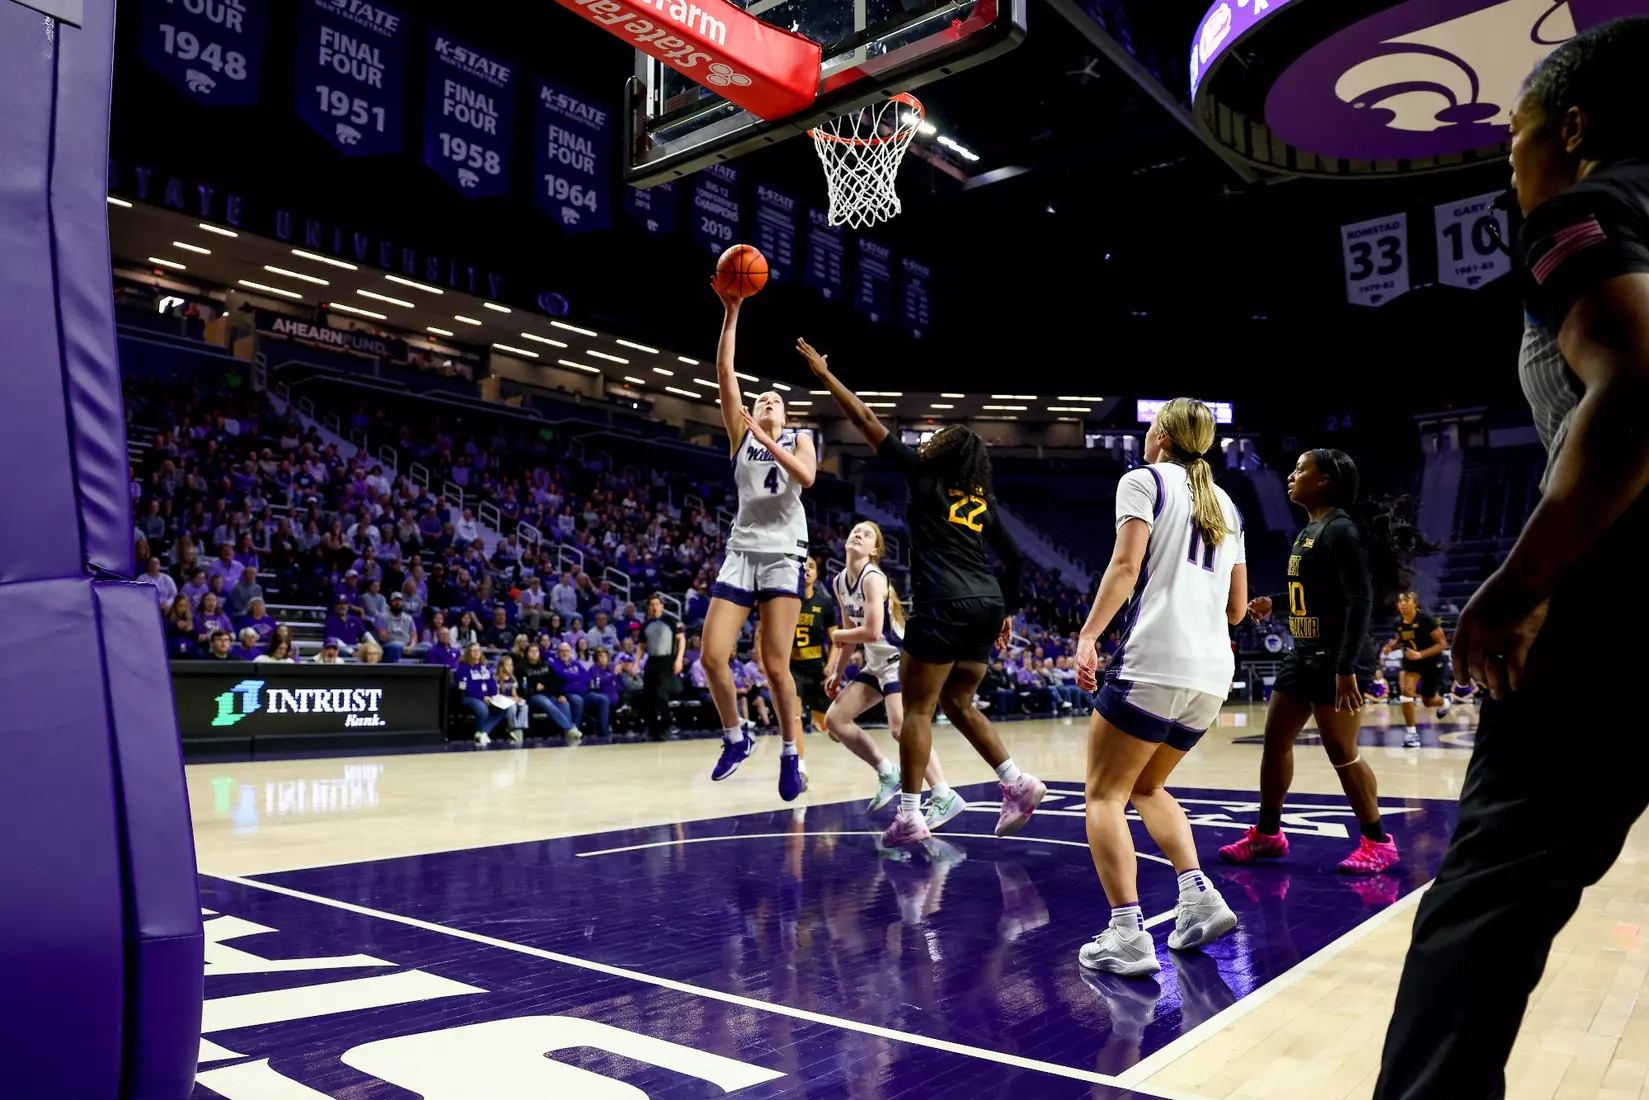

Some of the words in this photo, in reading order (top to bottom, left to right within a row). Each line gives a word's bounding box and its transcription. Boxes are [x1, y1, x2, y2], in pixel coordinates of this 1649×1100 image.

[166, 0, 243, 34] OUR
[159, 24, 247, 81] 1948
[320, 25, 385, 70] FINAL
[435, 37, 511, 82] K-STATE
[319, 45, 382, 89] FOUR
[316, 85, 385, 132] 1951
[443, 97, 496, 135] FOUR
[444, 79, 499, 118] FINAL
[540, 85, 607, 125] K-STATE
[439, 132, 501, 175] 1958
[548, 141, 594, 175] FOUR
[549, 124, 596, 159] FINAL
[544, 174, 598, 213] 1964
[694, 195, 740, 223] CHAMPIONS
[719, 187, 729, 198] 12
[757, 185, 795, 210] K-STATE
[1453, 202, 1486, 218] GARY
[700, 215, 732, 240] 2019
[1347, 221, 1400, 240] ROMSTAD
[1442, 214, 1501, 262] 10
[276, 208, 501, 300] UNIVERSITY
[859, 238, 890, 258] K-STATE
[1349, 235, 1403, 282] 33
[763, 466, 779, 495] 4
[948, 488, 987, 533] 22
[796, 627, 811, 647] 5
[266, 688, 383, 714] INTRUST
